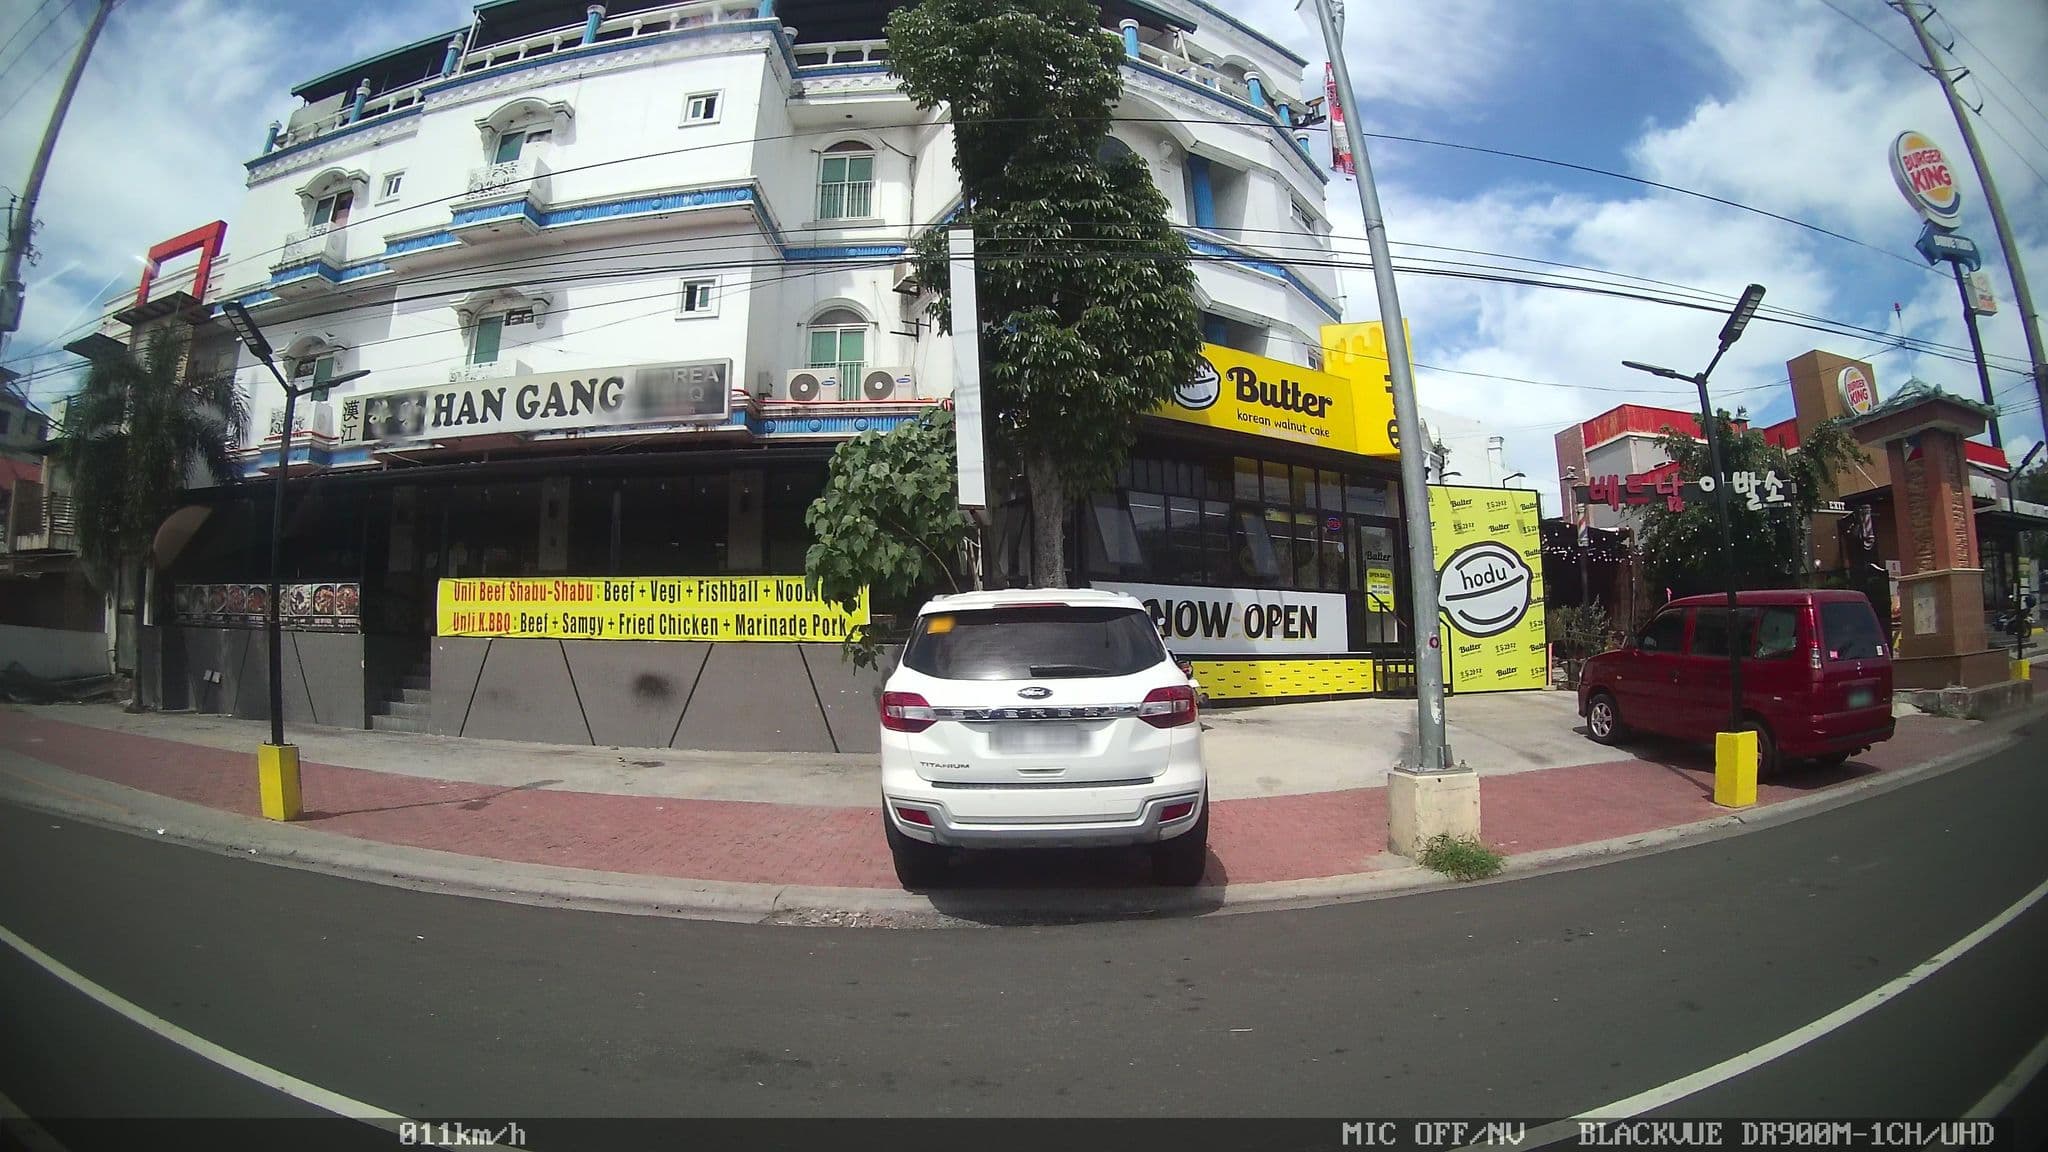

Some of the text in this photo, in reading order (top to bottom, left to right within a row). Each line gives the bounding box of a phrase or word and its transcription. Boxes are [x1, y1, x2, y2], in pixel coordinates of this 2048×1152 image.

[1902, 149, 1944, 172] BURGER
[1910, 165, 1952, 193] KING
[432, 387, 507, 428] HAN
[516, 376, 625, 420] GANG
[1226, 366, 1333, 418] Butter
[1850, 388, 1868, 404] KING
[341, 399, 360, 444] 漢江
[1237, 409, 1330, 438] korean walnut cake
[1699, 470, 1785, 511] 이발소
[1450, 498, 1473, 508] Butter
[1828, 501, 1846, 510] EXIT
[1488, 523, 1511, 533] Butter
[1460, 563, 1507, 590] hodu
[454, 580, 476, 602] Unli
[480, 580, 506, 602] Beef
[604, 581, 635, 602] Beef
[651, 581, 681, 604] Vegi
[698, 580, 758, 602] Fishball
[453, 612, 475, 632] Unli
[520, 612, 549, 633] Beef
[563, 612, 604, 636] Samgy
[619, 613, 654, 635] Fried
[660, 613, 718, 636] Chicken
[735, 614, 807, 636] Marinade
[813, 614, 847, 637] Pork
[1143, 598, 1318, 640] NOW OPEN
[1459, 643, 1482, 653] Butter
[1496, 667, 1518, 677] Butter
[920, 761, 970, 769] TITANIUM
